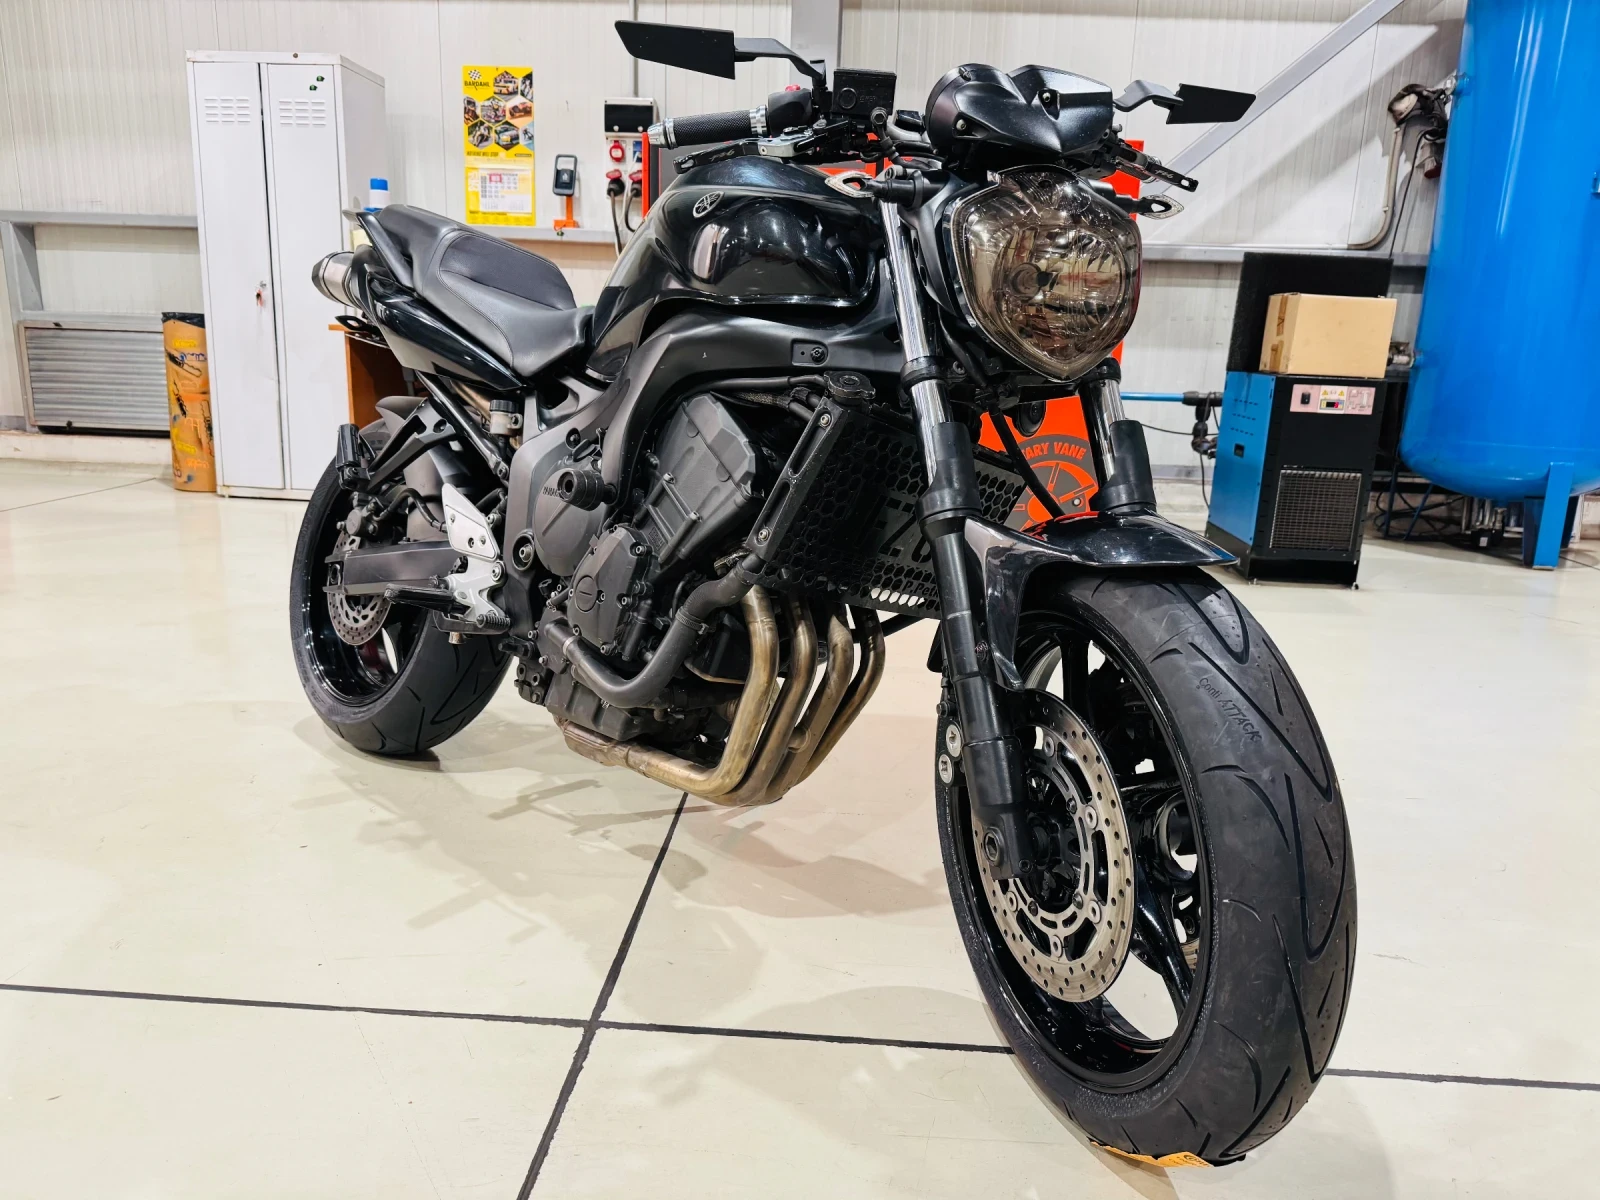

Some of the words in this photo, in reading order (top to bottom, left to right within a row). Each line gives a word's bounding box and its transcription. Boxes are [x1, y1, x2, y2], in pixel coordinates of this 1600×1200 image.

[464, 81, 490, 89] BARDAHL
[1054, 441, 1087, 461] VANE
[1199, 677, 1223, 699] Conti
[1217, 699, 1262, 742] ATTACK
